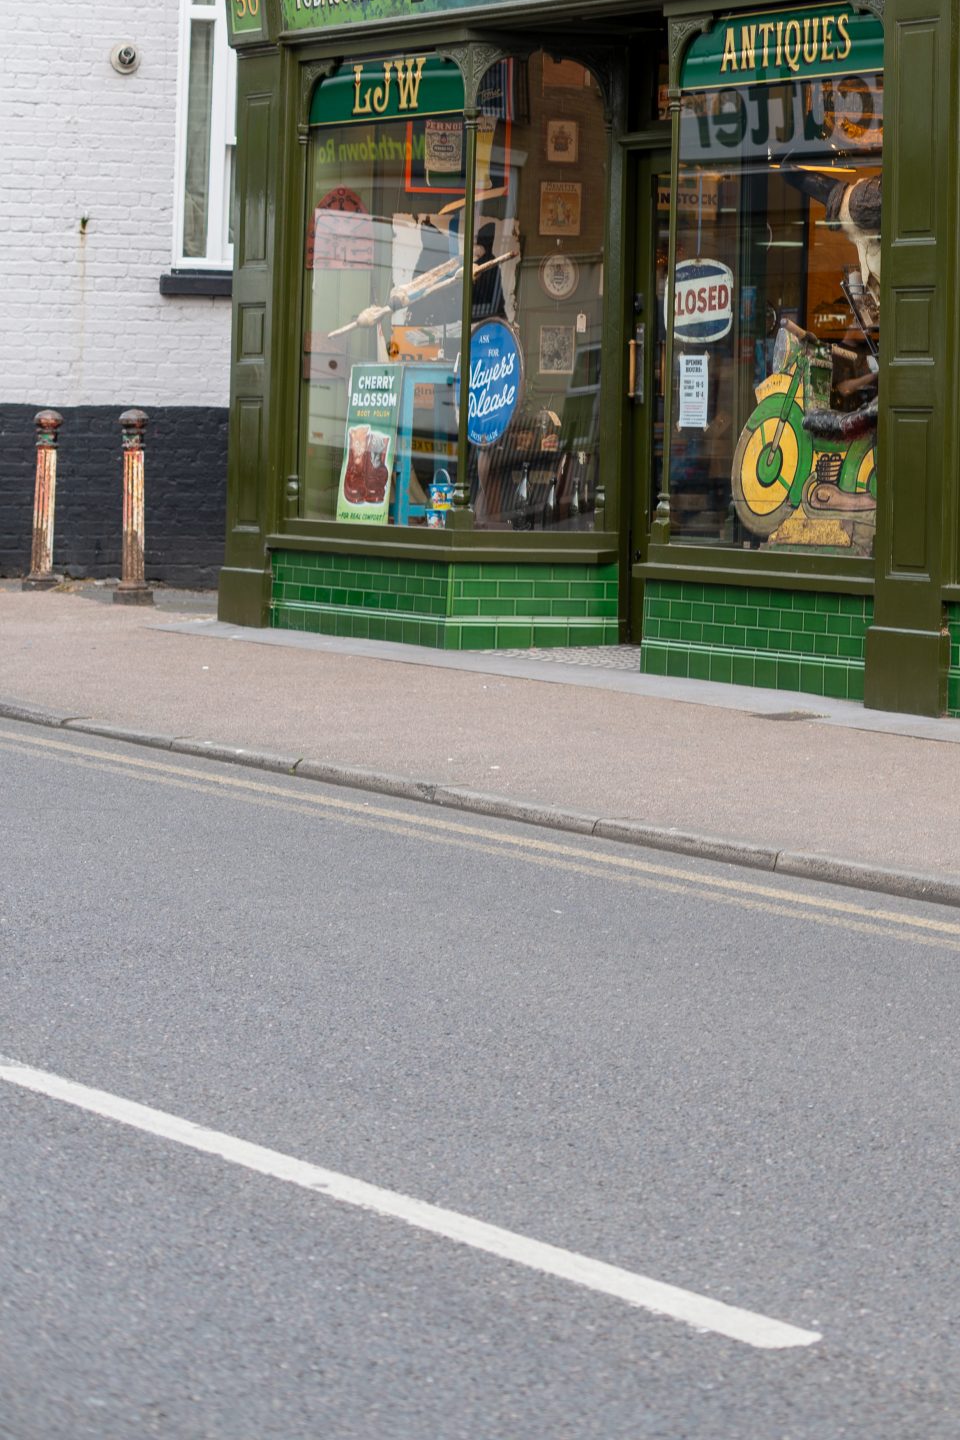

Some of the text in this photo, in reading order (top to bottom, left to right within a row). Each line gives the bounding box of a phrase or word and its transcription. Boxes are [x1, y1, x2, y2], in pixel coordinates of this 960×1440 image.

[720, 13, 852, 73] ANTIQUES
[674, 283, 729, 316] LOSED
[479, 334, 490, 344] ASK
[487, 348, 500, 357] FOR
[358, 375, 395, 390] CHERRY
[351, 392, 398, 407] BLOSSOM
